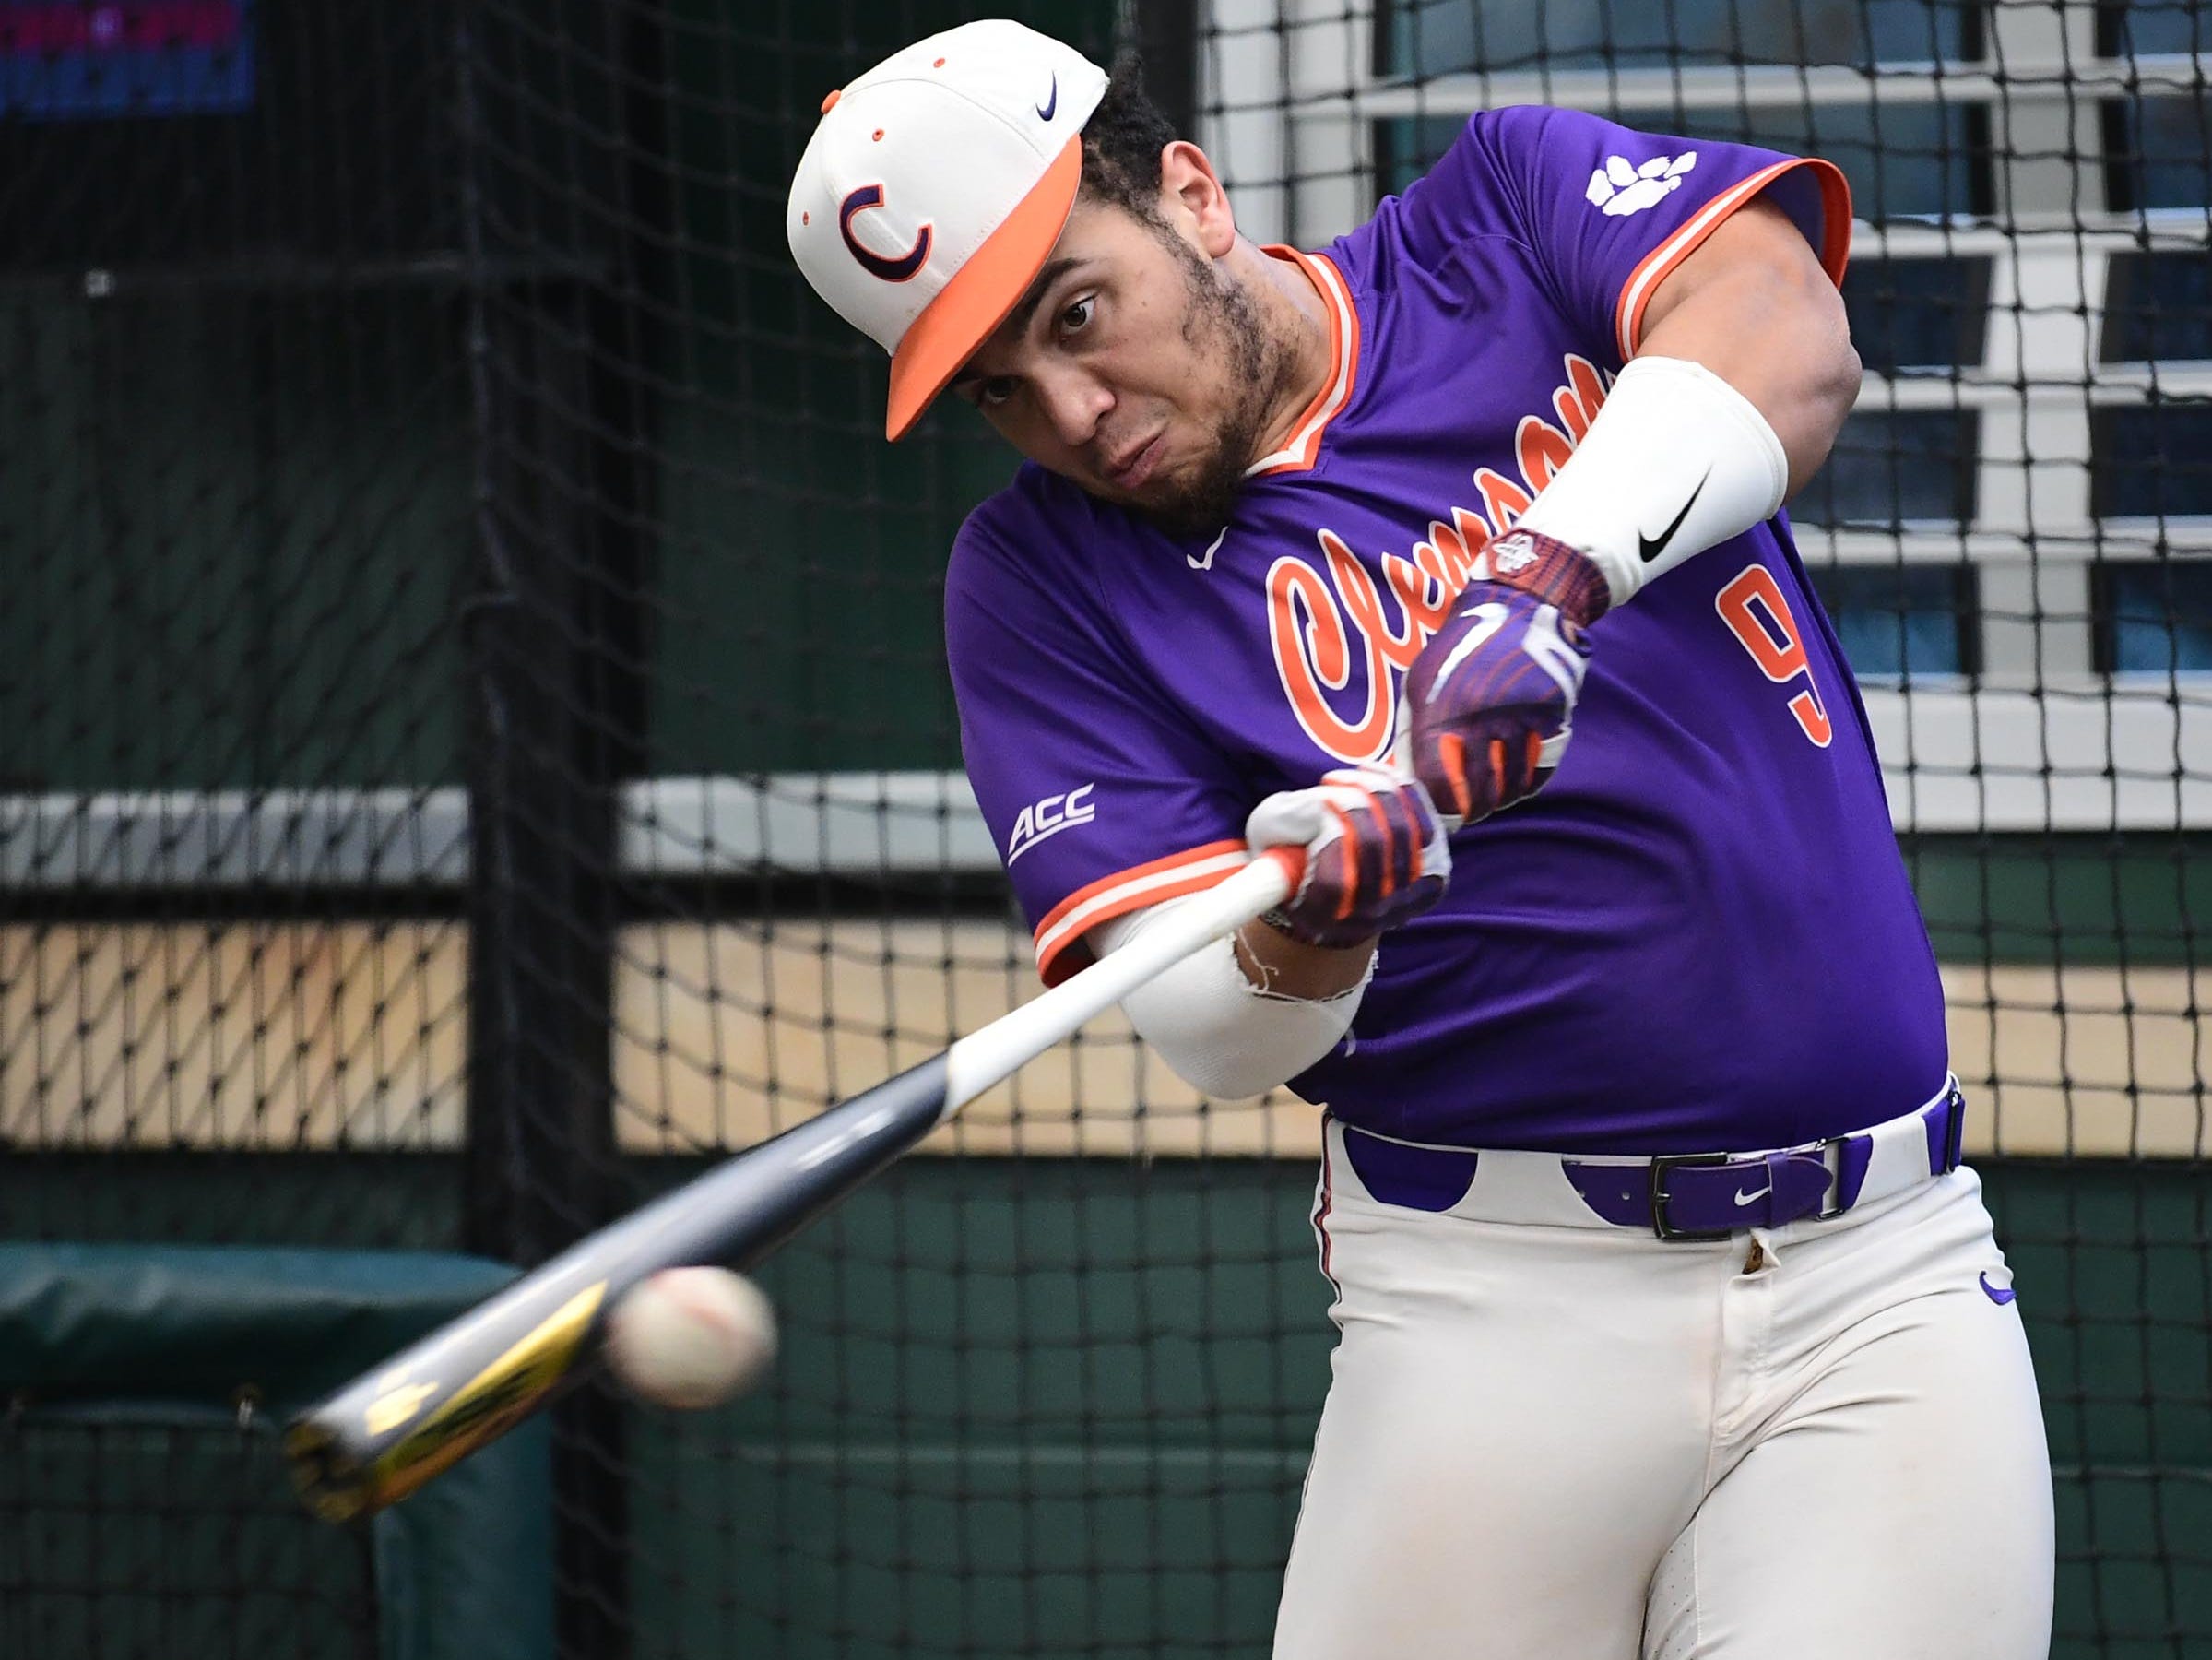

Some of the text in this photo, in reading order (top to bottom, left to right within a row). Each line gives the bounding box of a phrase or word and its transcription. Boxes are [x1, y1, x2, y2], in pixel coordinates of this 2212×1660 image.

[838, 183, 933, 284] C
[1715, 563, 1833, 749] 9
[1007, 781, 1096, 856] ACC
